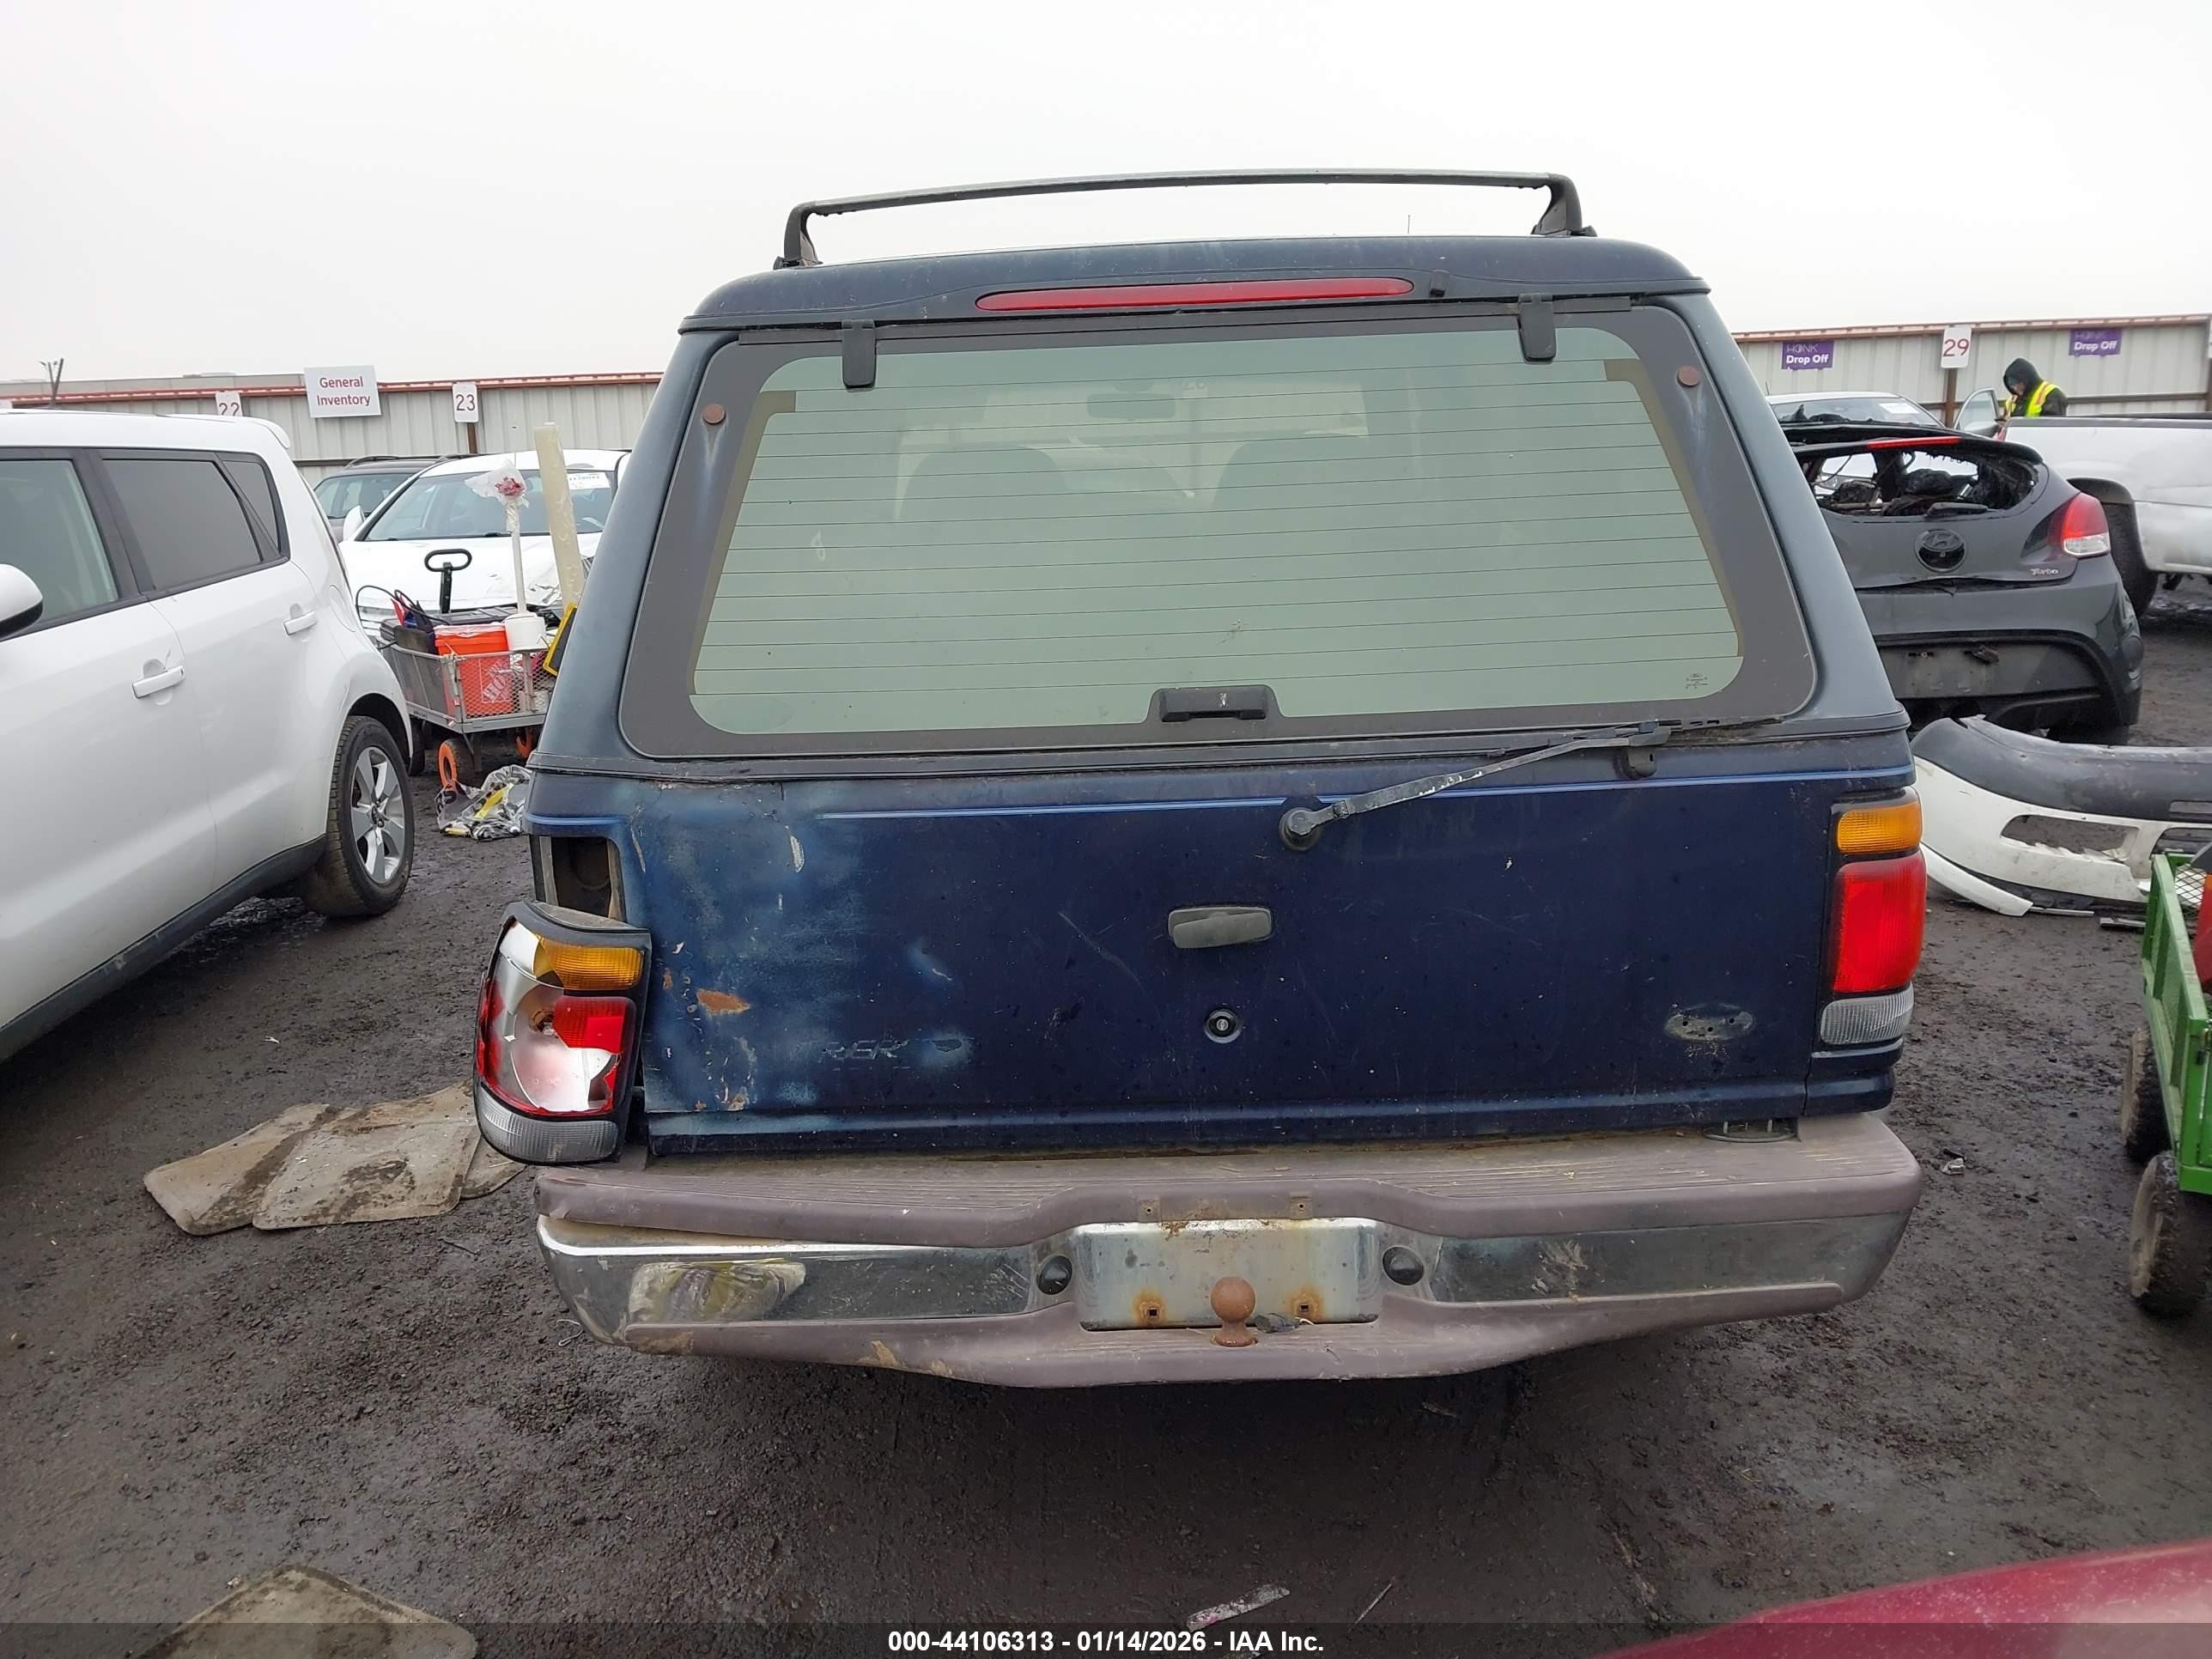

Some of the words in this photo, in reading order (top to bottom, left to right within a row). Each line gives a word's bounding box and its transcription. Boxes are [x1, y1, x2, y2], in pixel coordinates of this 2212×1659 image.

[1942, 338, 1969, 357] 29
[2074, 341, 2099, 352] Drop
[2100, 340, 2118, 350] Off
[1786, 355, 1810, 366] Drop
[1812, 353, 1829, 363] Off
[319, 376, 364, 389] General
[317, 394, 371, 406] Inventory
[455, 394, 476, 411] 23
